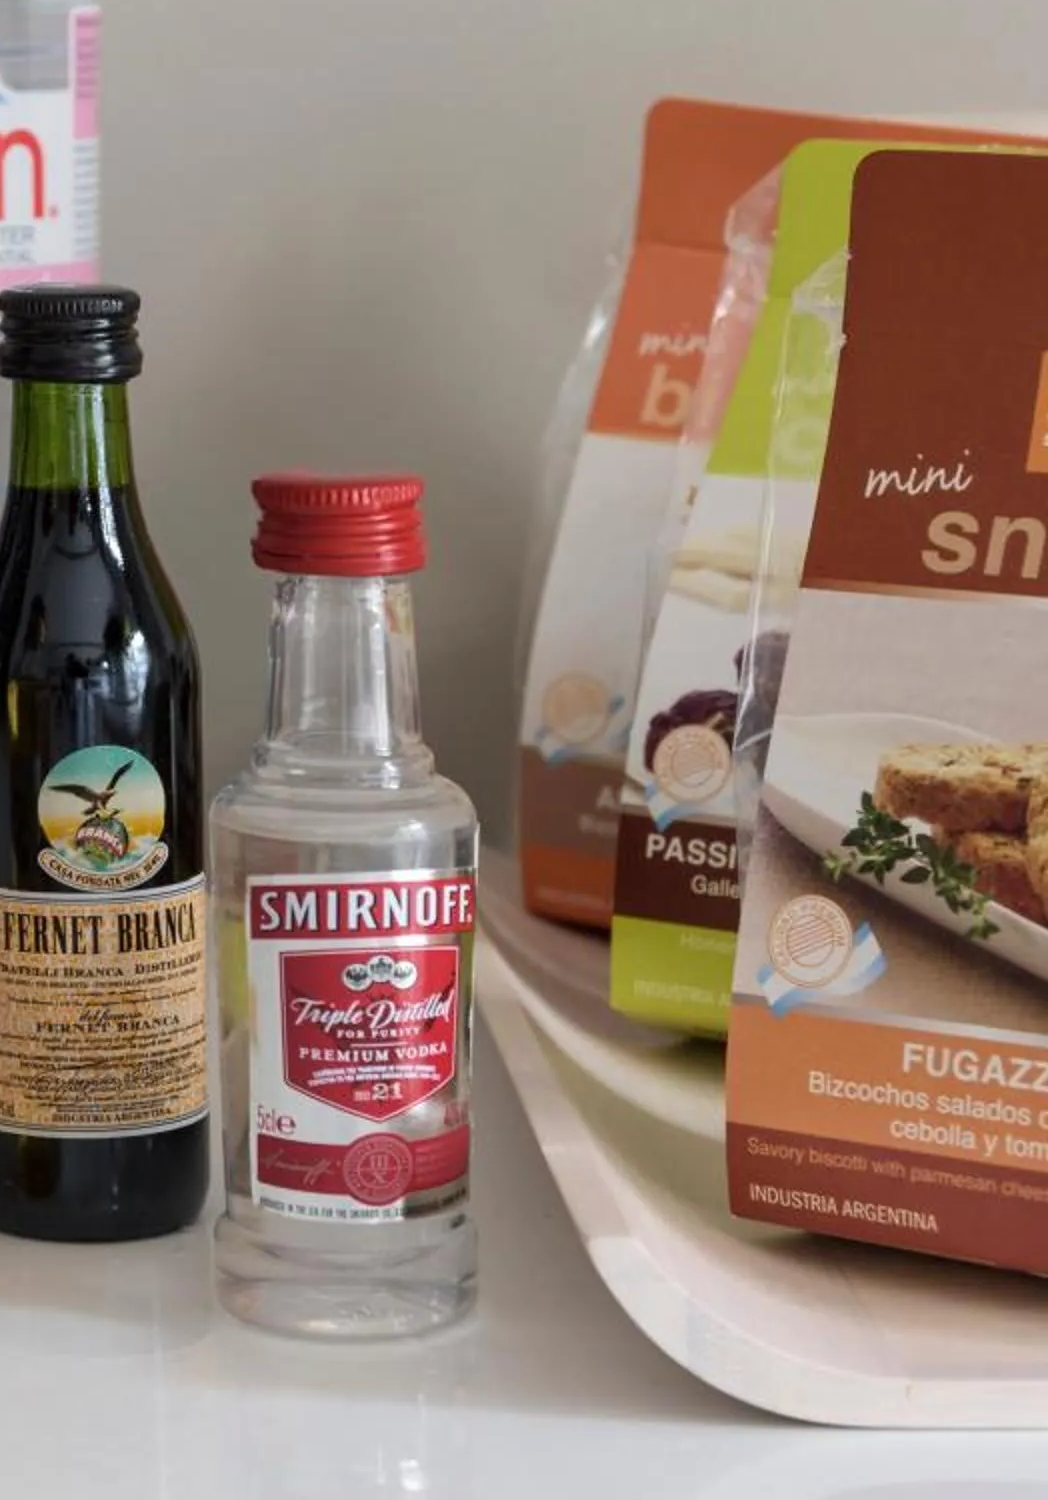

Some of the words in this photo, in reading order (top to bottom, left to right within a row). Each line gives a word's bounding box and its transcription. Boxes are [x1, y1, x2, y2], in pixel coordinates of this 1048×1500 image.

[863, 448, 974, 499] mini
[3, 911, 103, 955] FERNET
[116, 901, 196, 954] BRANCA
[63, 964, 124, 978] BRANCA
[36, 1022, 111, 1034] FERNET
[116, 1014, 181, 1033] BRANCA
[289, 997, 364, 1033] Triple
[366, 989, 454, 1030] Distilled
[299, 1047, 390, 1062] PREMIUM
[395, 1041, 448, 1060] VODKA
[336, 1029, 365, 1039] FOR
[808, 1070, 930, 1112] Bizcochos
[936, 1094, 1032, 1126] salados
[889, 1119, 977, 1150] cebolla
[983, 1133, 999, 1158] y
[746, 1137, 804, 1166] Savory
[809, 1148, 868, 1172] biscotti
[871, 1159, 905, 1180] with
[910, 1167, 998, 1194] parmesan
[748, 1182, 839, 1215] INDUSTRIA
[841, 1199, 938, 1233] ARGENTINA
